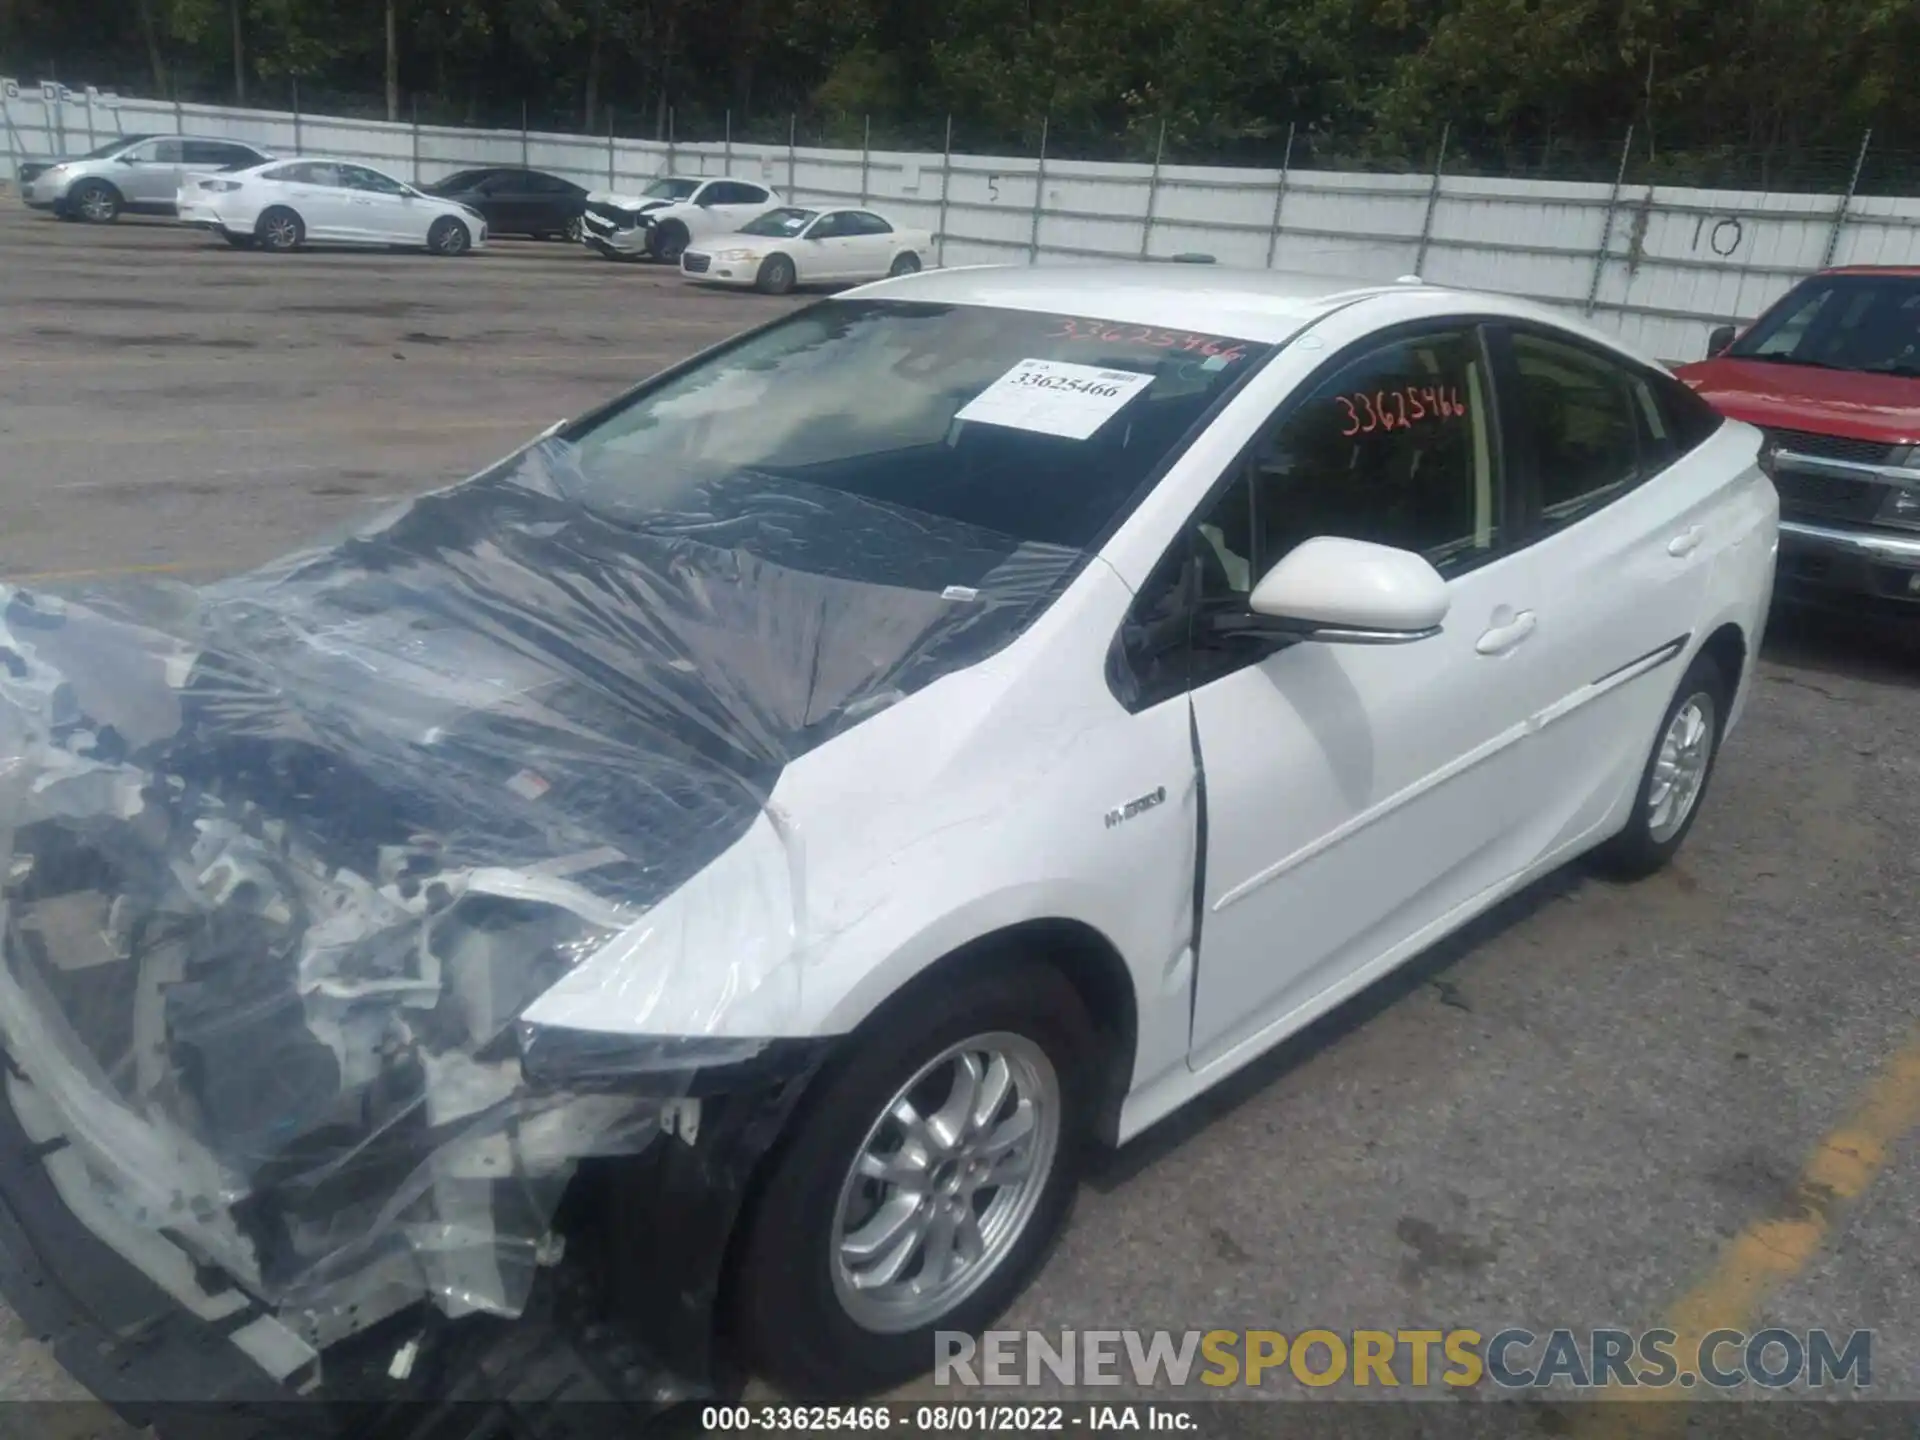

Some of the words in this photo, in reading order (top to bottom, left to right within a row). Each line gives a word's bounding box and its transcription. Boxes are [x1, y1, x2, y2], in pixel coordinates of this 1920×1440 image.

[1691, 216, 1742, 257] 10
[1048, 318, 1247, 362] 33625466
[1009, 371, 1119, 399] 33625466
[1335, 384, 1465, 436] 33625466
